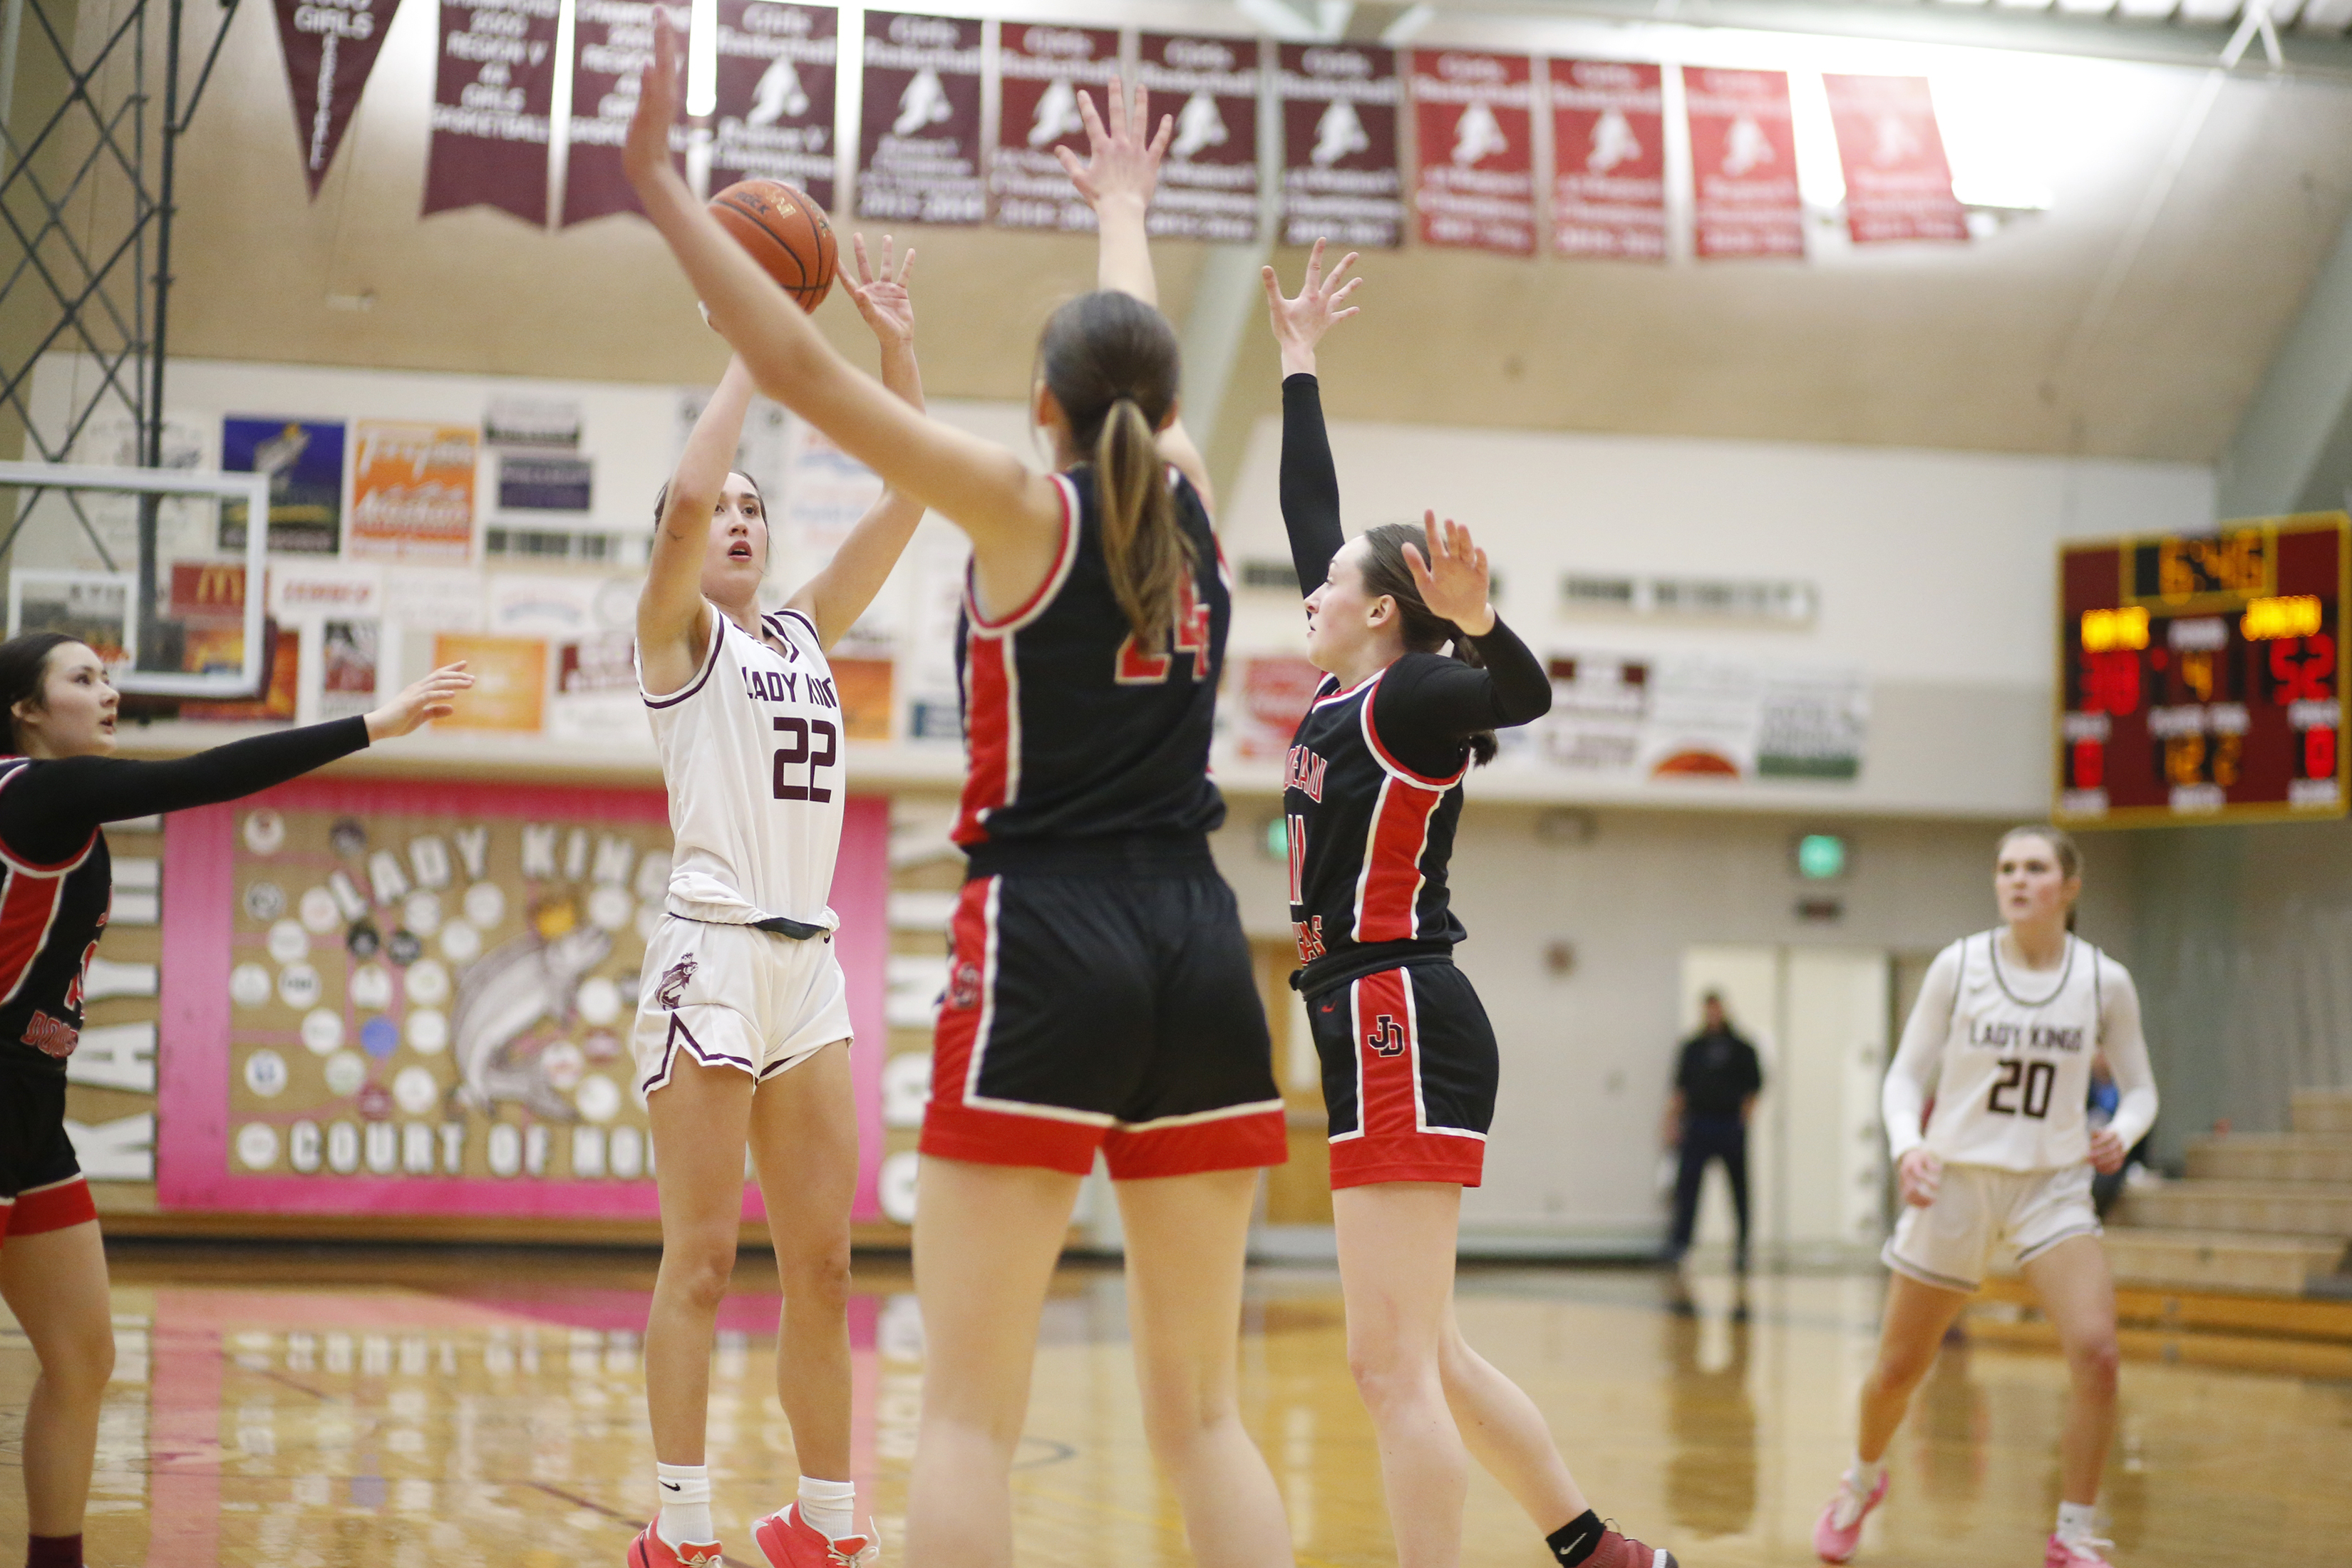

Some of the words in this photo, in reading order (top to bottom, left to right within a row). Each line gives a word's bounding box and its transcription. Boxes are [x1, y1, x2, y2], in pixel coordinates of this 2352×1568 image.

[294, 6, 375, 40] GIRLS
[741, 666, 798, 703] LADY
[773, 716, 836, 804] 22
[329, 825, 489, 922] LADY
[1287, 814, 1306, 905] 11
[63, 814, 158, 1182] KAYH
[1368, 1014, 1405, 1058] JD
[1969, 1019, 2021, 1048] LADY
[1987, 1058, 2056, 1118] 20
[289, 1120, 467, 1175] COURT
[488, 1123, 552, 1178] OF
[573, 1125, 657, 1179] HO
